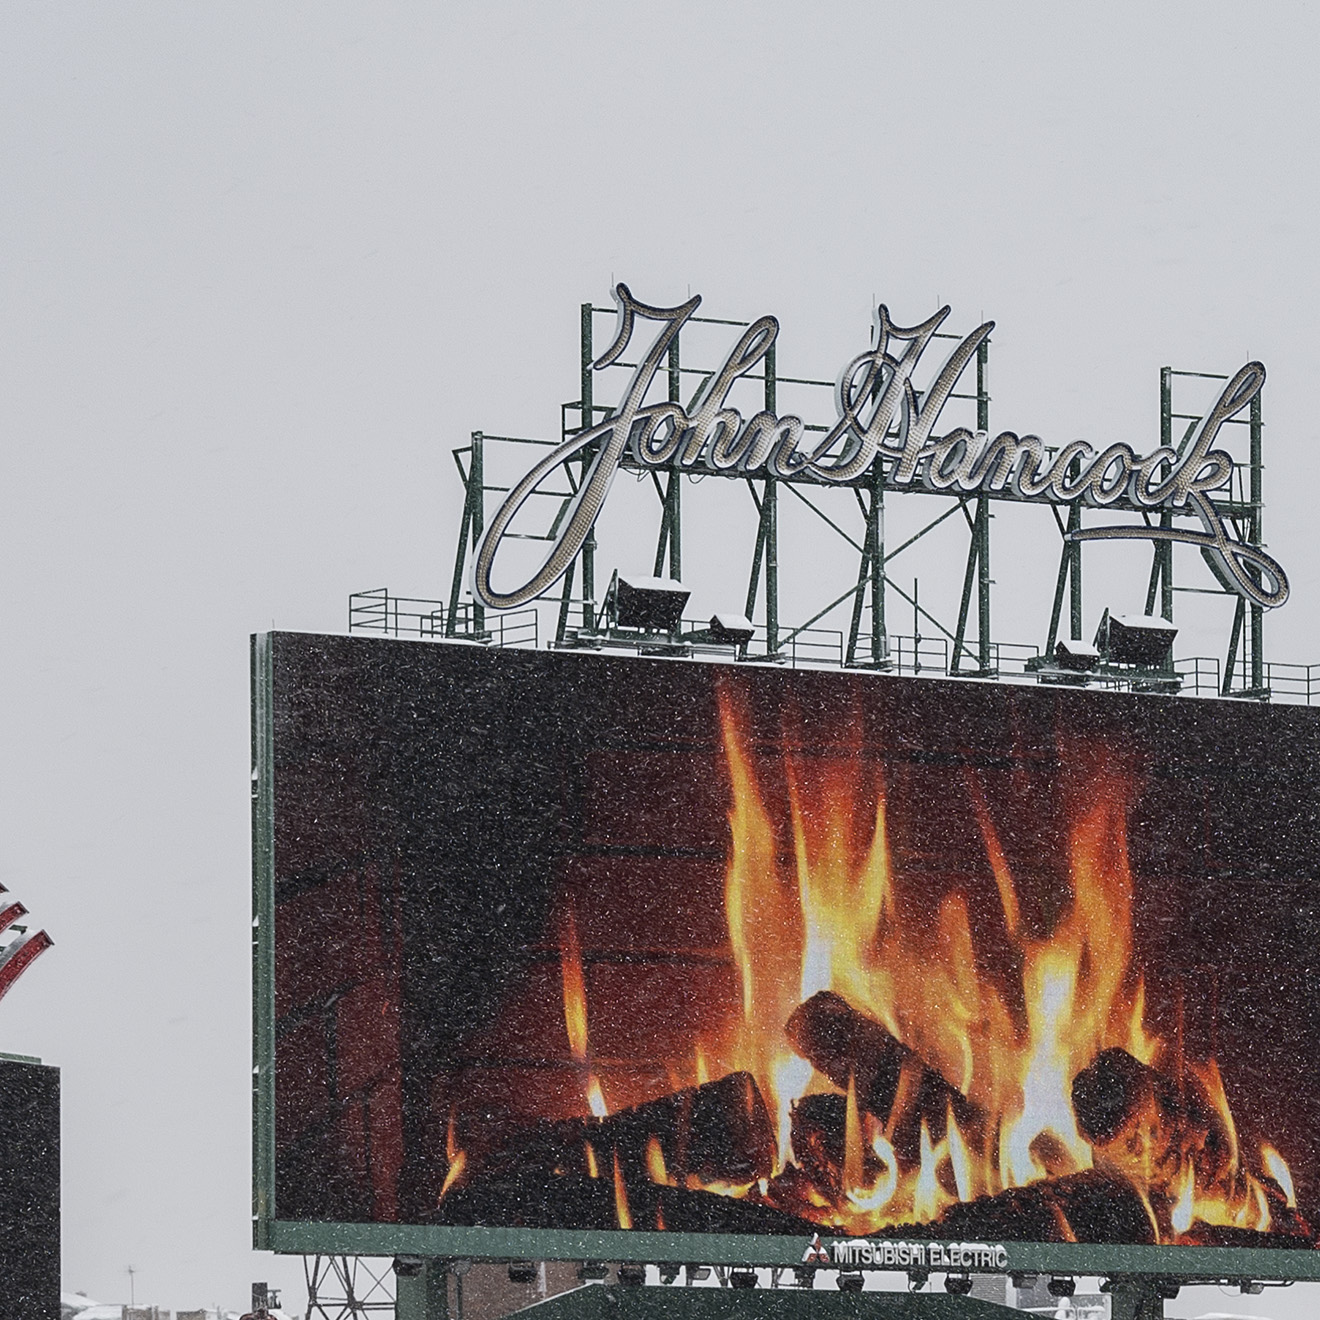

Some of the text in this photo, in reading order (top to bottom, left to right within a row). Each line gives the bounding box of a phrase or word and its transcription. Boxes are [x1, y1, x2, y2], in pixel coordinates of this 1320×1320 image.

[471, 282, 1289, 608] John Hancock
[832, 1243, 1008, 1268] MITSUBISHI ELECTRIC
